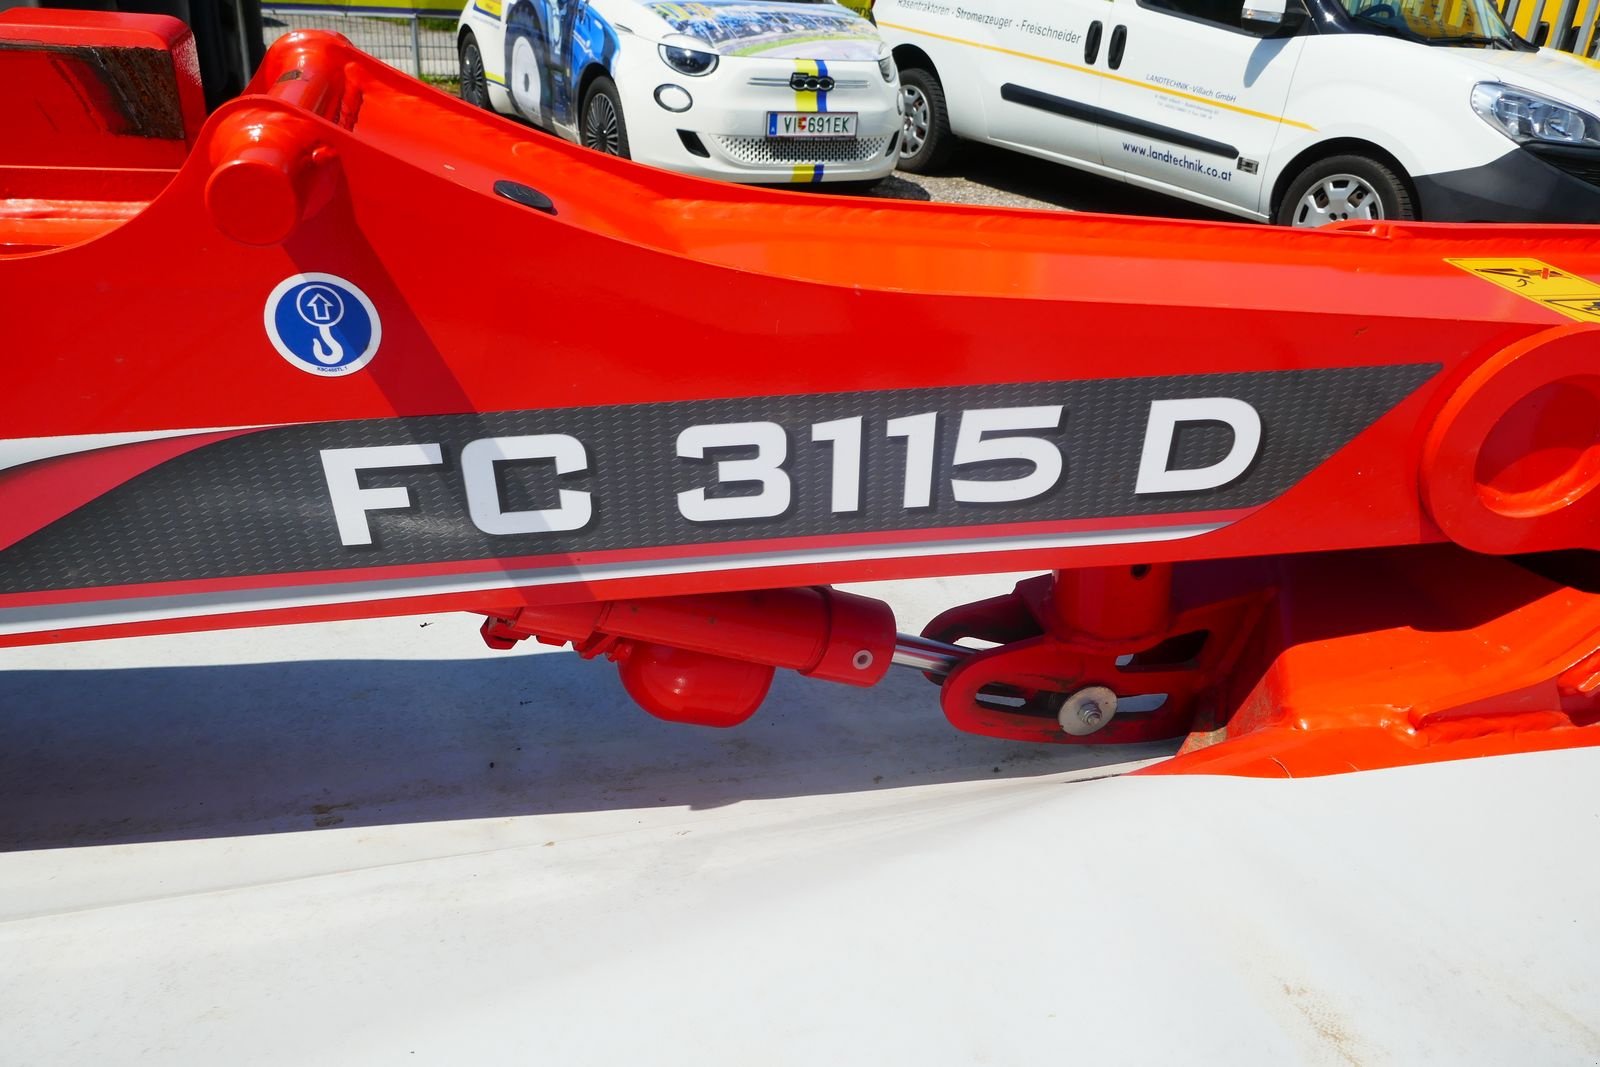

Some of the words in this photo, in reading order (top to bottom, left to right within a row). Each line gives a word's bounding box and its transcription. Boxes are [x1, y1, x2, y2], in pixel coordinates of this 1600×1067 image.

[955, 7, 1013, 30] Stromerzeuger
[1021, 19, 1082, 45] Freischneider
[1215, 91, 1237, 103] GmbH
[784, 117, 797, 133] VI
[808, 117, 850, 133] 691EK
[1122, 142, 1232, 182] www.landtechnik.co.at
[319, 434, 593, 547] FC
[676, 404, 1065, 522] 3115
[1134, 397, 1263, 495] D
